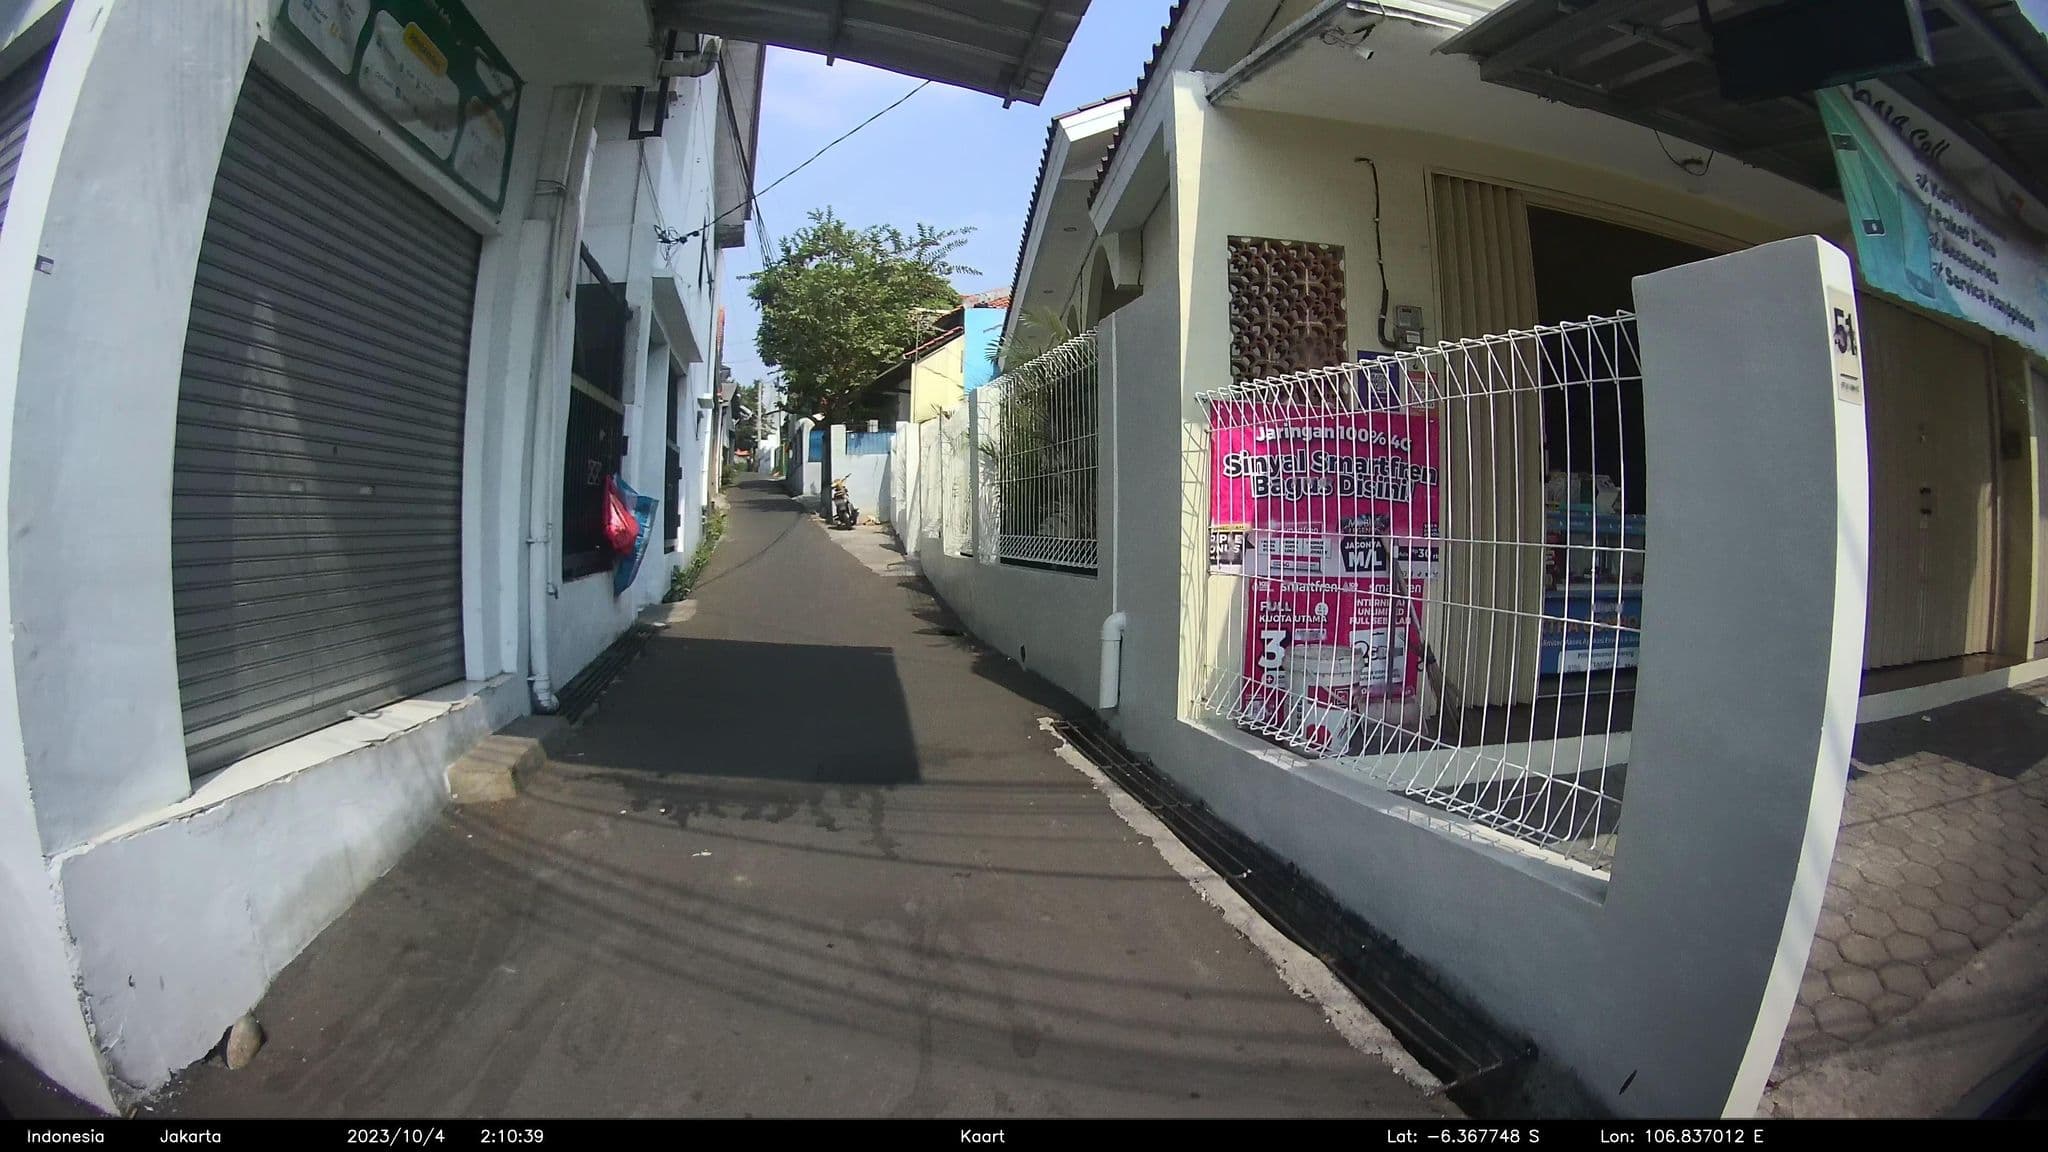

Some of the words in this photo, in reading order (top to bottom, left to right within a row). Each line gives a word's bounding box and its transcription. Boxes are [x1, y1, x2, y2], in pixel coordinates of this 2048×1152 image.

[1256, 422, 1335, 442] Jaringan
[1223, 450, 1307, 478] Sinyal
[1311, 449, 1438, 486] Smartfren
[1251, 474, 1334, 501] Bagus
[1348, 549, 1383, 569] M/L
[1260, 601, 1292, 612] FULL
[1259, 614, 1292, 623] KUOTA
[1293, 614, 1328, 623] UTAMA
